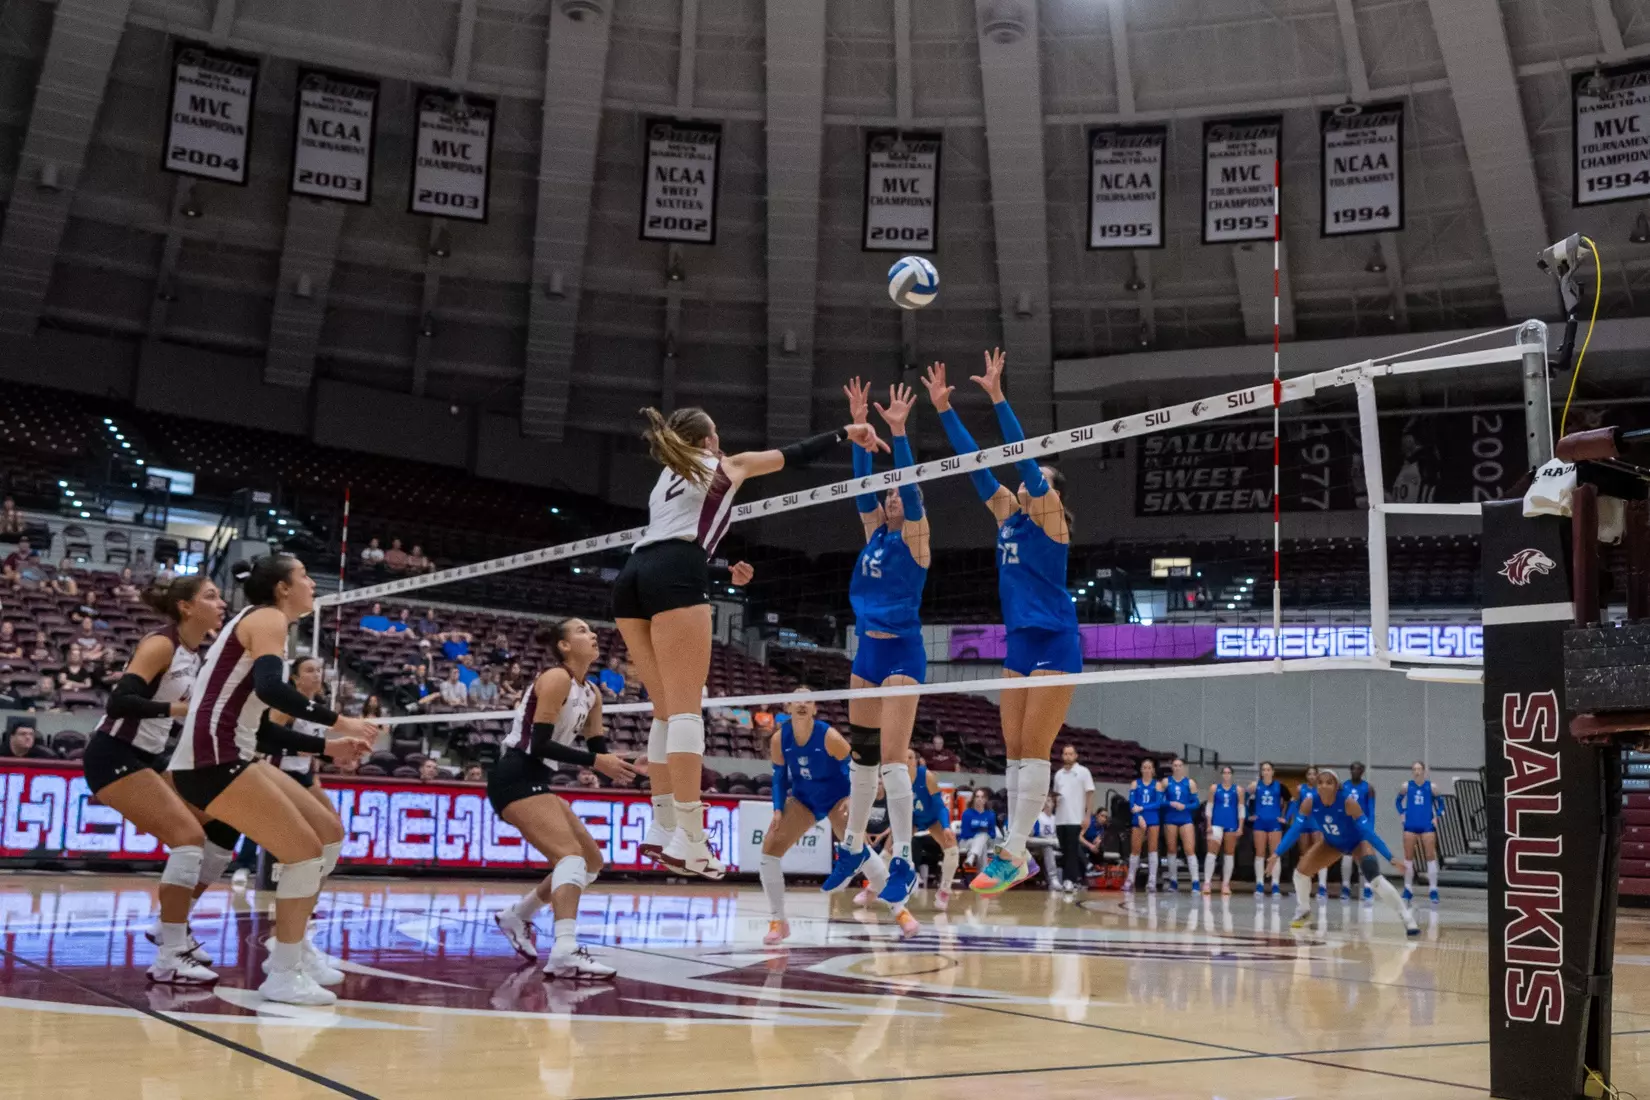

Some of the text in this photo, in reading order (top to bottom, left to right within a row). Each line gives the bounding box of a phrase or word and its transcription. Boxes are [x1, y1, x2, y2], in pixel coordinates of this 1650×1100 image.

[190, 94, 232, 120] MVC
[173, 112, 245, 136] CHAMPIONS
[306, 118, 361, 142] NCAA
[1594, 115, 1641, 139] MVC
[300, 138, 366, 155] TOURNAMENT
[431, 139, 472, 160] MVC
[1582, 135, 1650, 154] TOURNAMEN
[171, 146, 239, 172] 2004
[418, 156, 483, 175] CHAMPIONS
[1333, 152, 1389, 174] NCAA
[1580, 150, 1650, 170] CHAMPION
[298, 170, 362, 191] 2003
[655, 166, 705, 185] NCAA
[1100, 173, 1153, 190] NCAA
[1221, 164, 1262, 184] MVC
[1329, 172, 1395, 188] TOURNAMENT
[1586, 170, 1650, 192] 1994
[662, 186, 698, 197] SWEET
[882, 178, 920, 194] MVC
[1210, 184, 1273, 197] TOURNAMENT
[418, 190, 479, 209] 2003
[656, 198, 703, 210] SIXTEEN
[870, 195, 933, 206] CHAMPIONS
[1095, 191, 1157, 203] TOURNAMENT
[1208, 196, 1273, 211] CHAMPIONS
[1213, 215, 1270, 232] 1995
[1333, 204, 1391, 225] 1994
[648, 216, 708, 232] 2002
[1099, 223, 1153, 239] 1995
[870, 227, 930, 242] 2002
[1228, 391, 1257, 409] SIU
[1145, 410, 1171, 427] SIU
[1070, 428, 1094, 443] SIU
[1144, 430, 1276, 456] SALUKIS
[1003, 444, 1025, 458] SIU
[1472, 414, 1503, 502] 2002
[941, 458, 961, 472] SIU
[1300, 421, 1330, 510] 1977
[883, 471, 902, 485] SIU
[1143, 466, 1249, 489] SWEET
[665, 473, 685, 502] 2
[830, 484, 849, 497] SIU
[782, 495, 799, 507] SIU
[1143, 487, 1274, 512] SIXTEEN
[737, 505, 753, 517] SIU
[620, 531, 632, 540] SIU
[862, 549, 882, 579] 15
[1502, 689, 1564, 1025] SALUKIS
